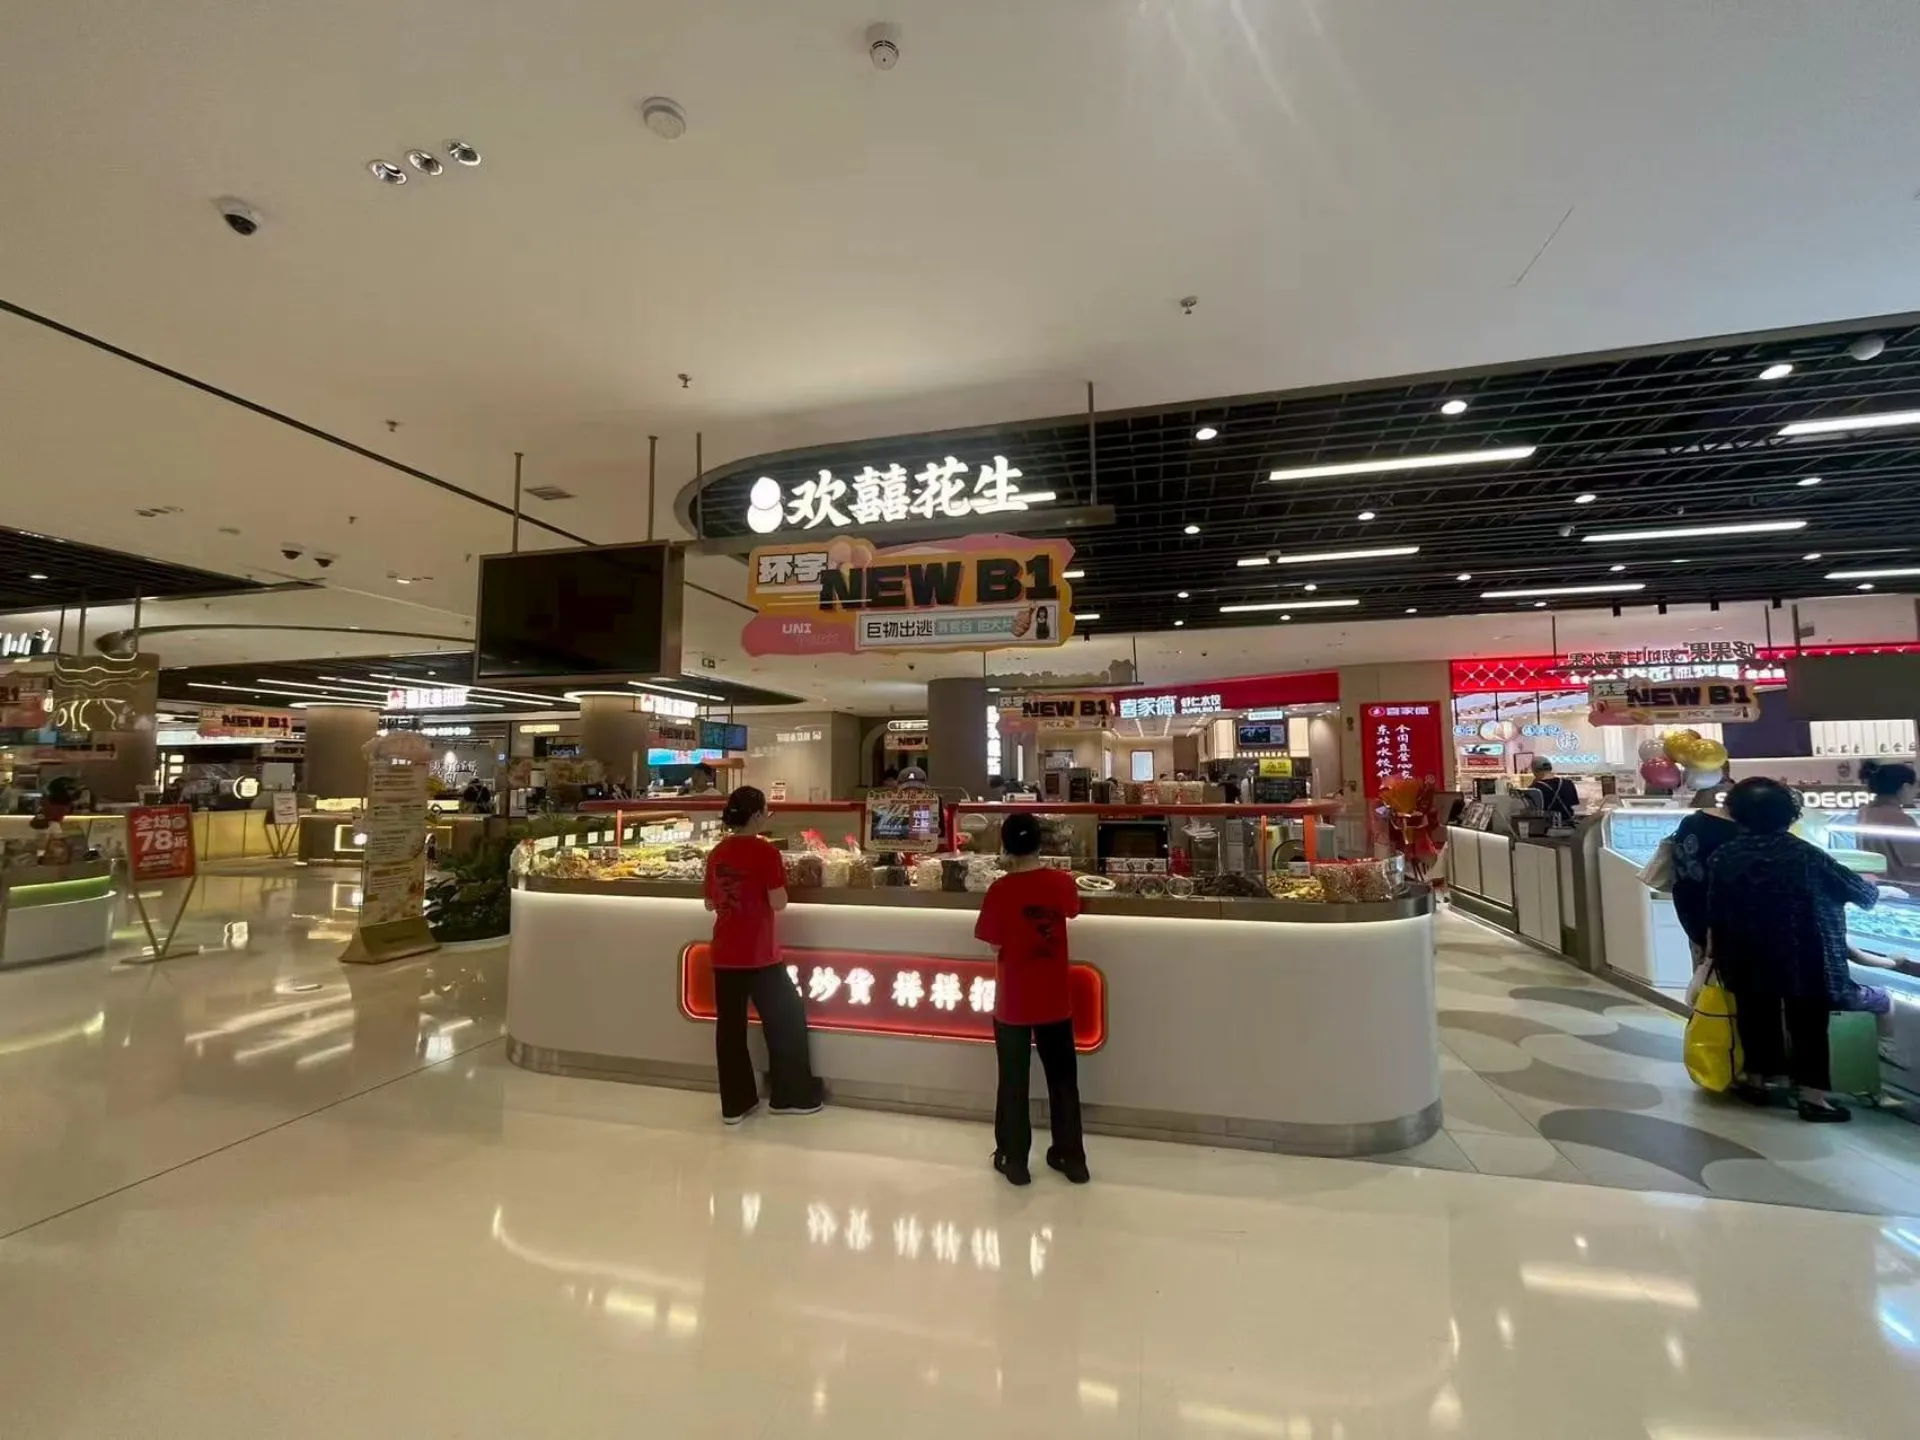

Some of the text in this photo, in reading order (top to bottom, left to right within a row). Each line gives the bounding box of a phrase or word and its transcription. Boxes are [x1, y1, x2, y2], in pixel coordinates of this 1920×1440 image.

[820, 554, 1061, 610] NEW B1
[782, 623, 812, 634] UNI
[867, 621, 932, 638] 巨物出逃
[1627, 685, 1751, 706] NEW B1
[1022, 700, 1109, 717] NEW B1
[222, 715, 289, 728] NEW B1
